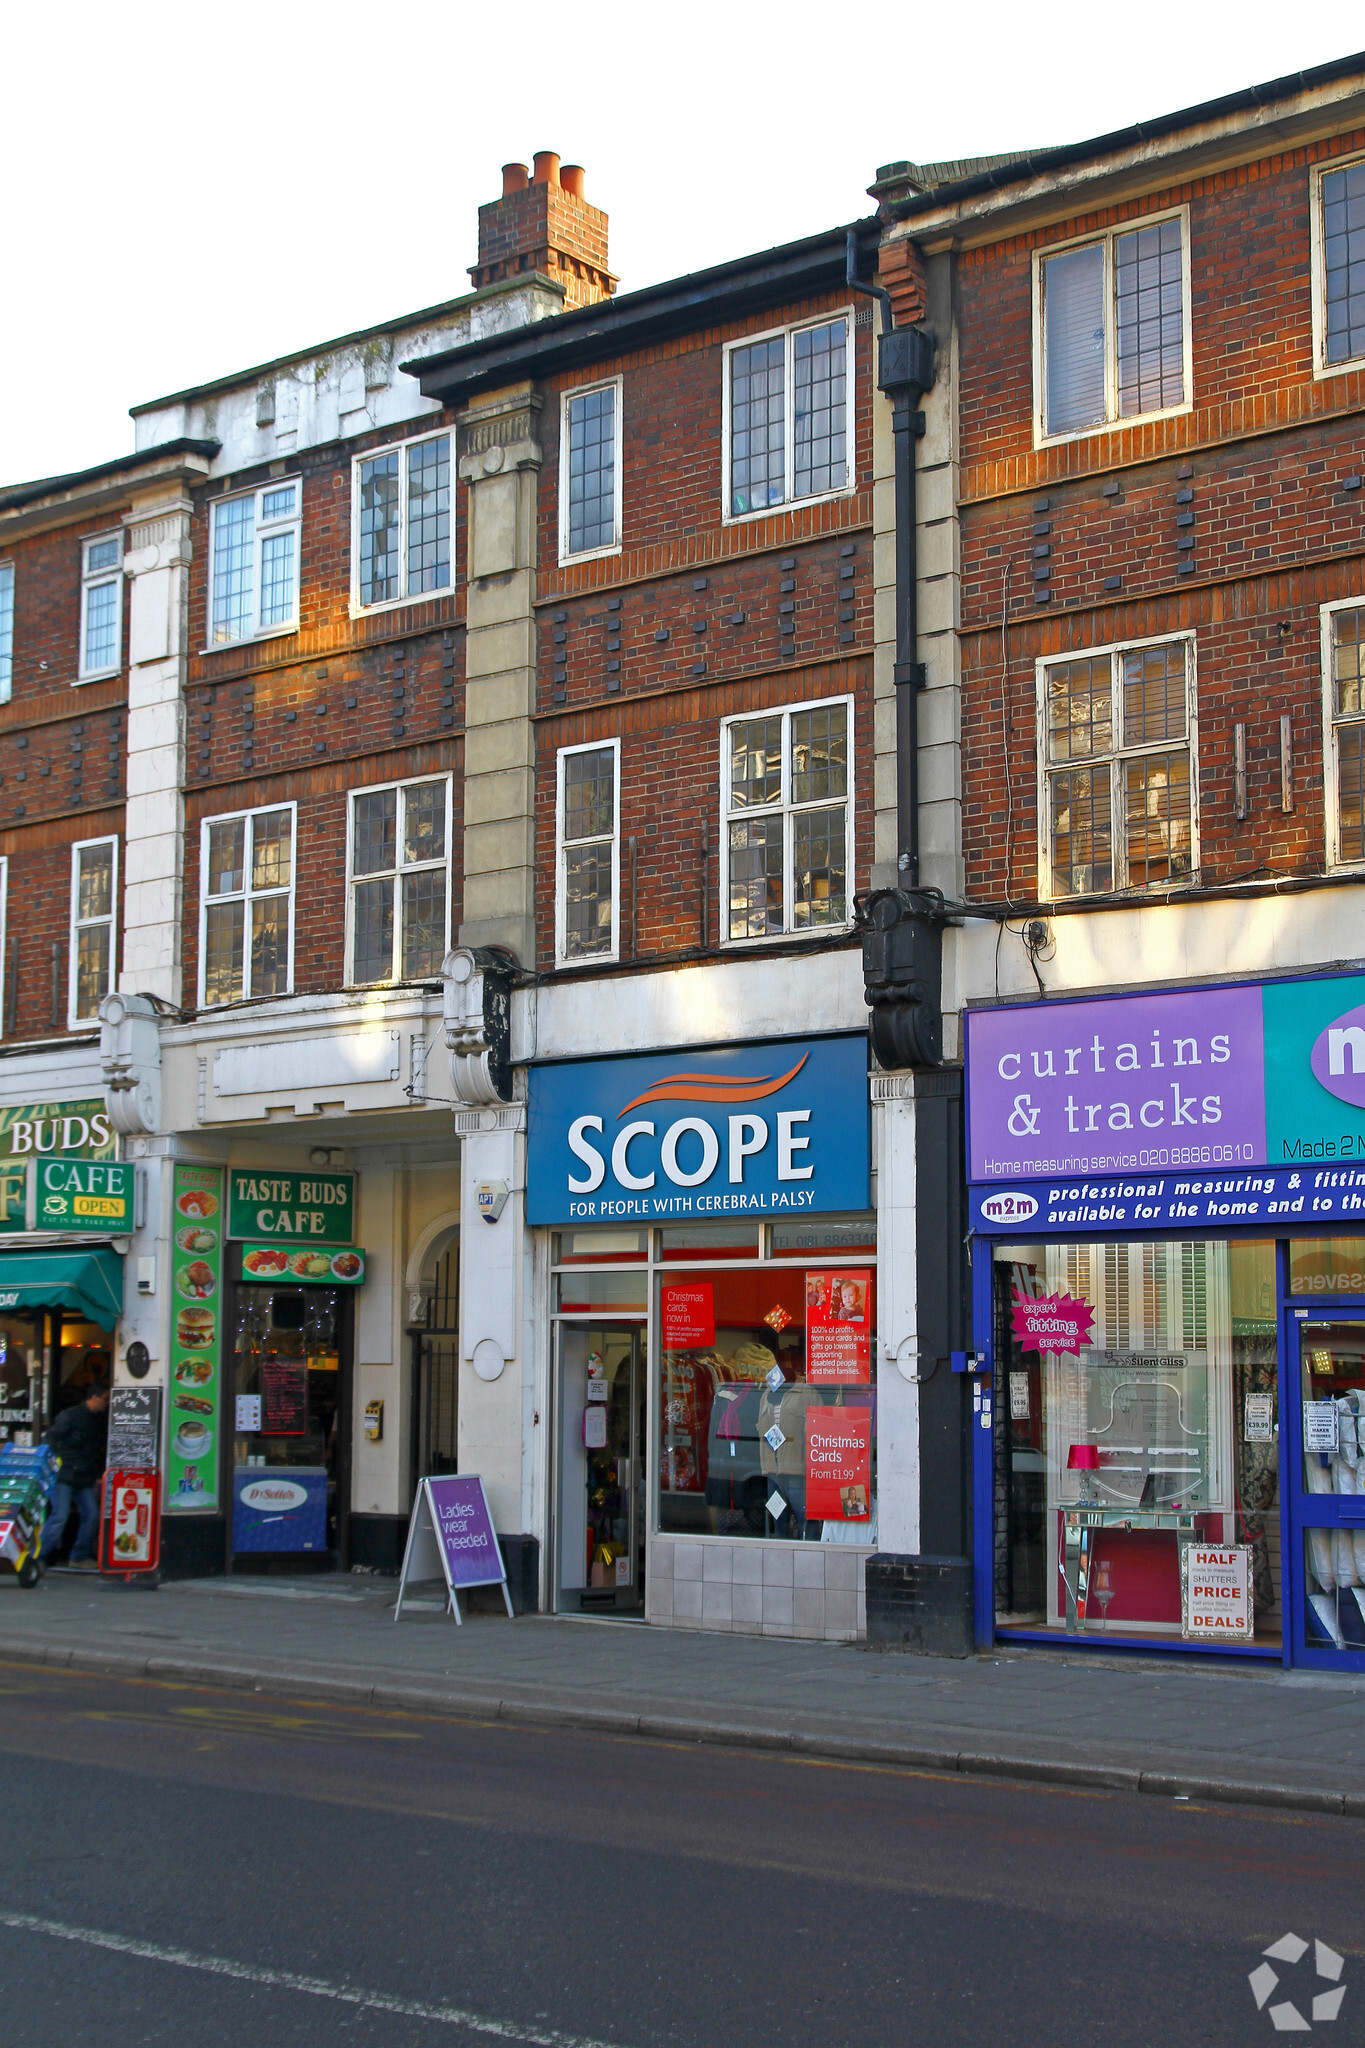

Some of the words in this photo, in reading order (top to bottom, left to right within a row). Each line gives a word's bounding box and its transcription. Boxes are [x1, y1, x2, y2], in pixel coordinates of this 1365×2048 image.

[998, 1029, 1231, 1080] curtains
[1007, 1094, 1041, 1137] &
[1064, 1082, 1222, 1133] tracks
[9, 1113, 110, 1154] BUDS
[568, 1109, 814, 1194] SCOPE
[1283, 1137, 1336, 1159] Made
[1340, 1135, 1354, 1156] 2
[984, 1159, 1021, 1175] Home
[1022, 1154, 1089, 1173] measuring
[1090, 1151, 1137, 1169] service
[1139, 1149, 1169, 1167] 020
[1171, 1146, 1210, 1165] 8886
[1213, 1143, 1254, 1162] 0610
[44, 1163, 125, 1195] CAFE
[236, 1178, 292, 1203] TASTE
[299, 1181, 348, 1206] BUDS
[1048, 1180, 1165, 1205] professional
[1174, 1175, 1276, 1195] measuring
[1287, 1173, 1302, 1190] &
[79, 1199, 120, 1213] OPEN
[479, 1194, 493, 1205] APT
[570, 1202, 596, 1217] FOR
[601, 1199, 649, 1215] PEOPLE
[653, 1197, 692, 1212] WITH
[696, 1194, 767, 1210] CEREBRAL
[771, 1190, 815, 1208] PALSY
[986, 1198, 1033, 1216] m2m
[1048, 1204, 1126, 1223] available
[1134, 1203, 1162, 1219] for
[1169, 1202, 1199, 1218] the
[1206, 1200, 1260, 1216] home
[1267, 1196, 1305, 1213] and
[1312, 1196, 1333, 1211] to
[256, 1209, 326, 1234] CAFE
[774, 1236, 793, 1249] TEL
[667, 1291, 704, 1302] Christmas
[667, 1303, 688, 1312] cards
[1023, 1302, 1057, 1316] expert
[667, 1314, 683, 1323] now
[684, 1313, 690, 1323] in
[835, 1325, 855, 1335] profits
[1026, 1317, 1079, 1336] fitting
[811, 1343, 824, 1351] gifts
[1039, 1338, 1076, 1348] service
[811, 1351, 843, 1359] supporting
[1131, 1357, 1184, 1366] SilentGliss
[810, 1434, 865, 1449] Christmas
[810, 1449, 842, 1463] Cards
[810, 1468, 831, 1479] From
[832, 1469, 854, 1480] £1.99
[438, 1502, 475, 1519] Ladies
[442, 1520, 468, 1533] wear
[446, 1531, 488, 1550] needed
[1196, 1553, 1237, 1565] HALF
[1193, 1575, 1238, 1584] SHUTTERS
[1194, 1586, 1241, 1598] PRICE
[1193, 1615, 1245, 1628] DEALS
